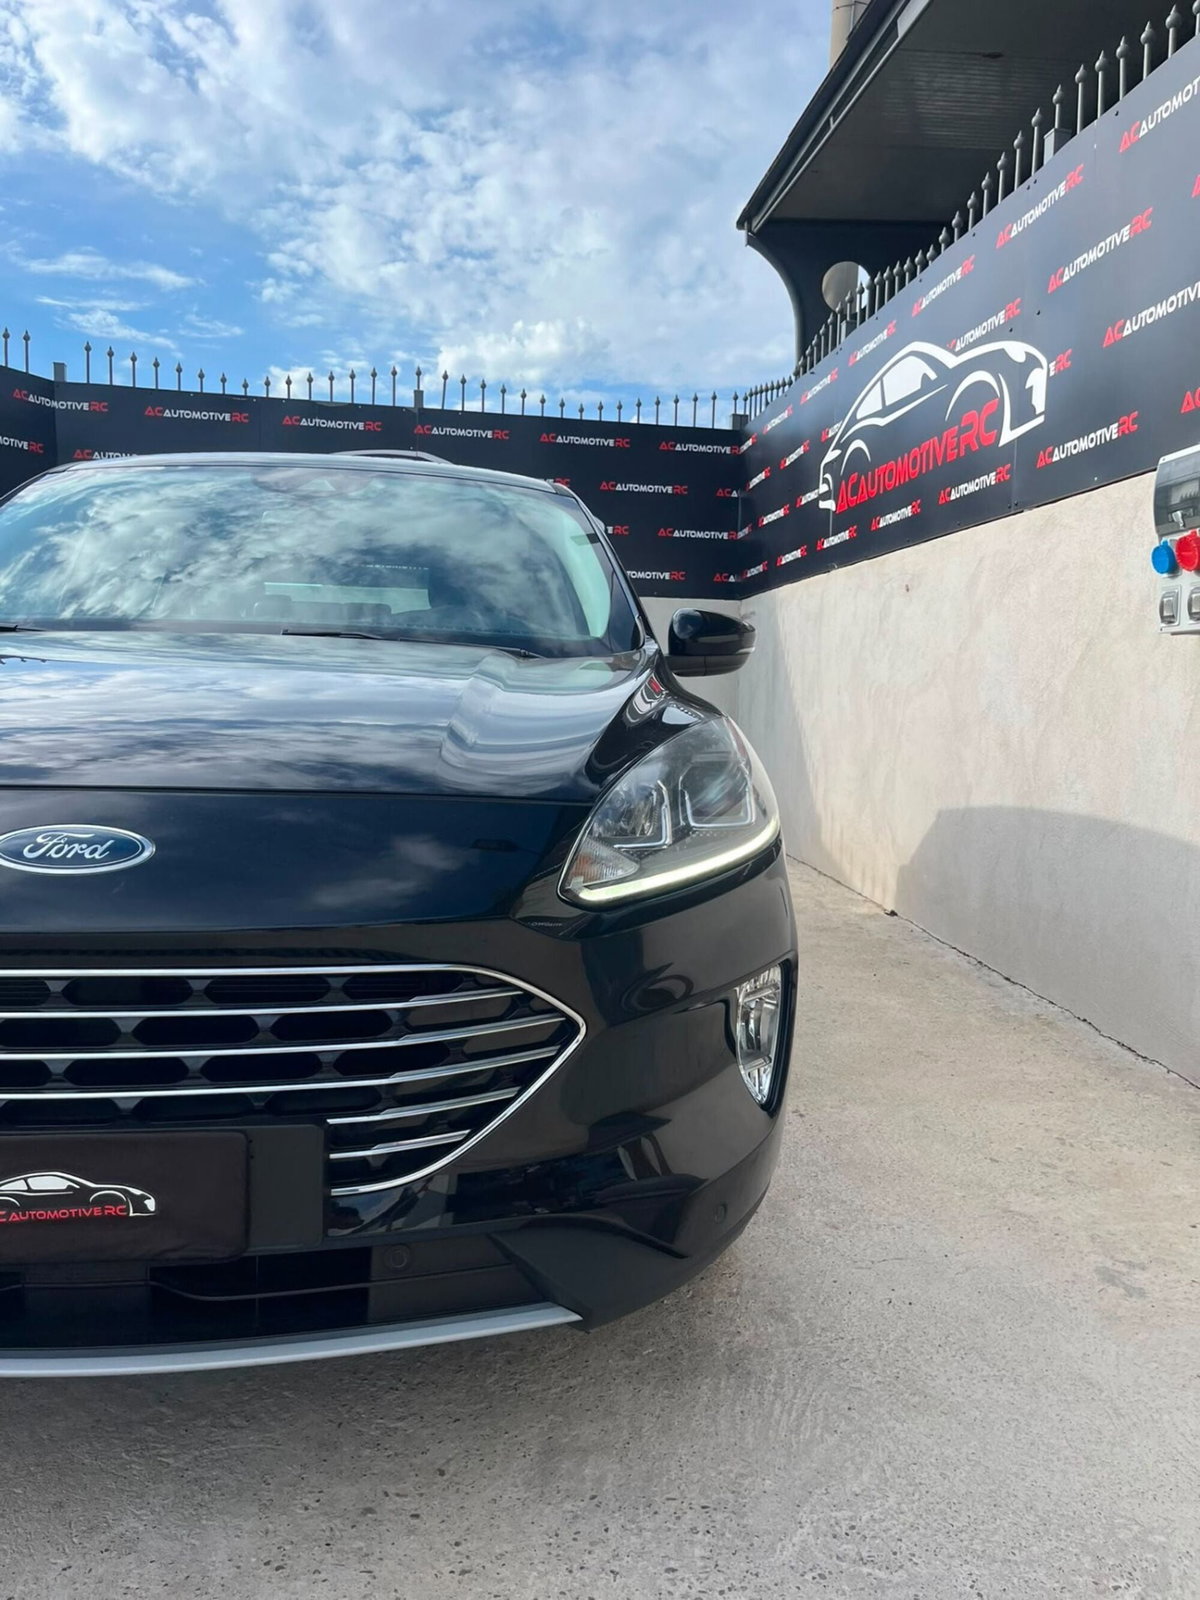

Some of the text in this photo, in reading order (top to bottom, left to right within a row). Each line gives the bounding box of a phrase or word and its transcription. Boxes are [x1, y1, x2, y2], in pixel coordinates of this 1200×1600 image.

[1118, 74, 1200, 153] ACAUTOMOT
[996, 163, 1084, 249] ACAUTOMOTIVERC
[1047, 207, 1153, 294] ACAUTOMOTIVERC
[911, 254, 976, 318] ACAUTOMOTIVERC
[12, 388, 109, 412] ACAUTOMOTIVERC
[144, 405, 249, 422] ACAUTOMOTIVERC
[282, 415, 383, 431] ACAUTOMOTIVERC
[414, 424, 510, 440] ACAUTOMOTIVERC
[540, 433, 630, 448] ACAUTOMOTIVERC
[836, 397, 999, 514] ACAUTOMOTIVERC
[1036, 411, 1139, 470] ACAUTOMOTIVERC
[600, 481, 688, 495] ACAUTOMOTIVERC
[938, 464, 1011, 504] ACAUTOMOTIVERC
[871, 499, 921, 532] ACAUTOMOTIVERC
[23, 831, 115, 859] Ford
